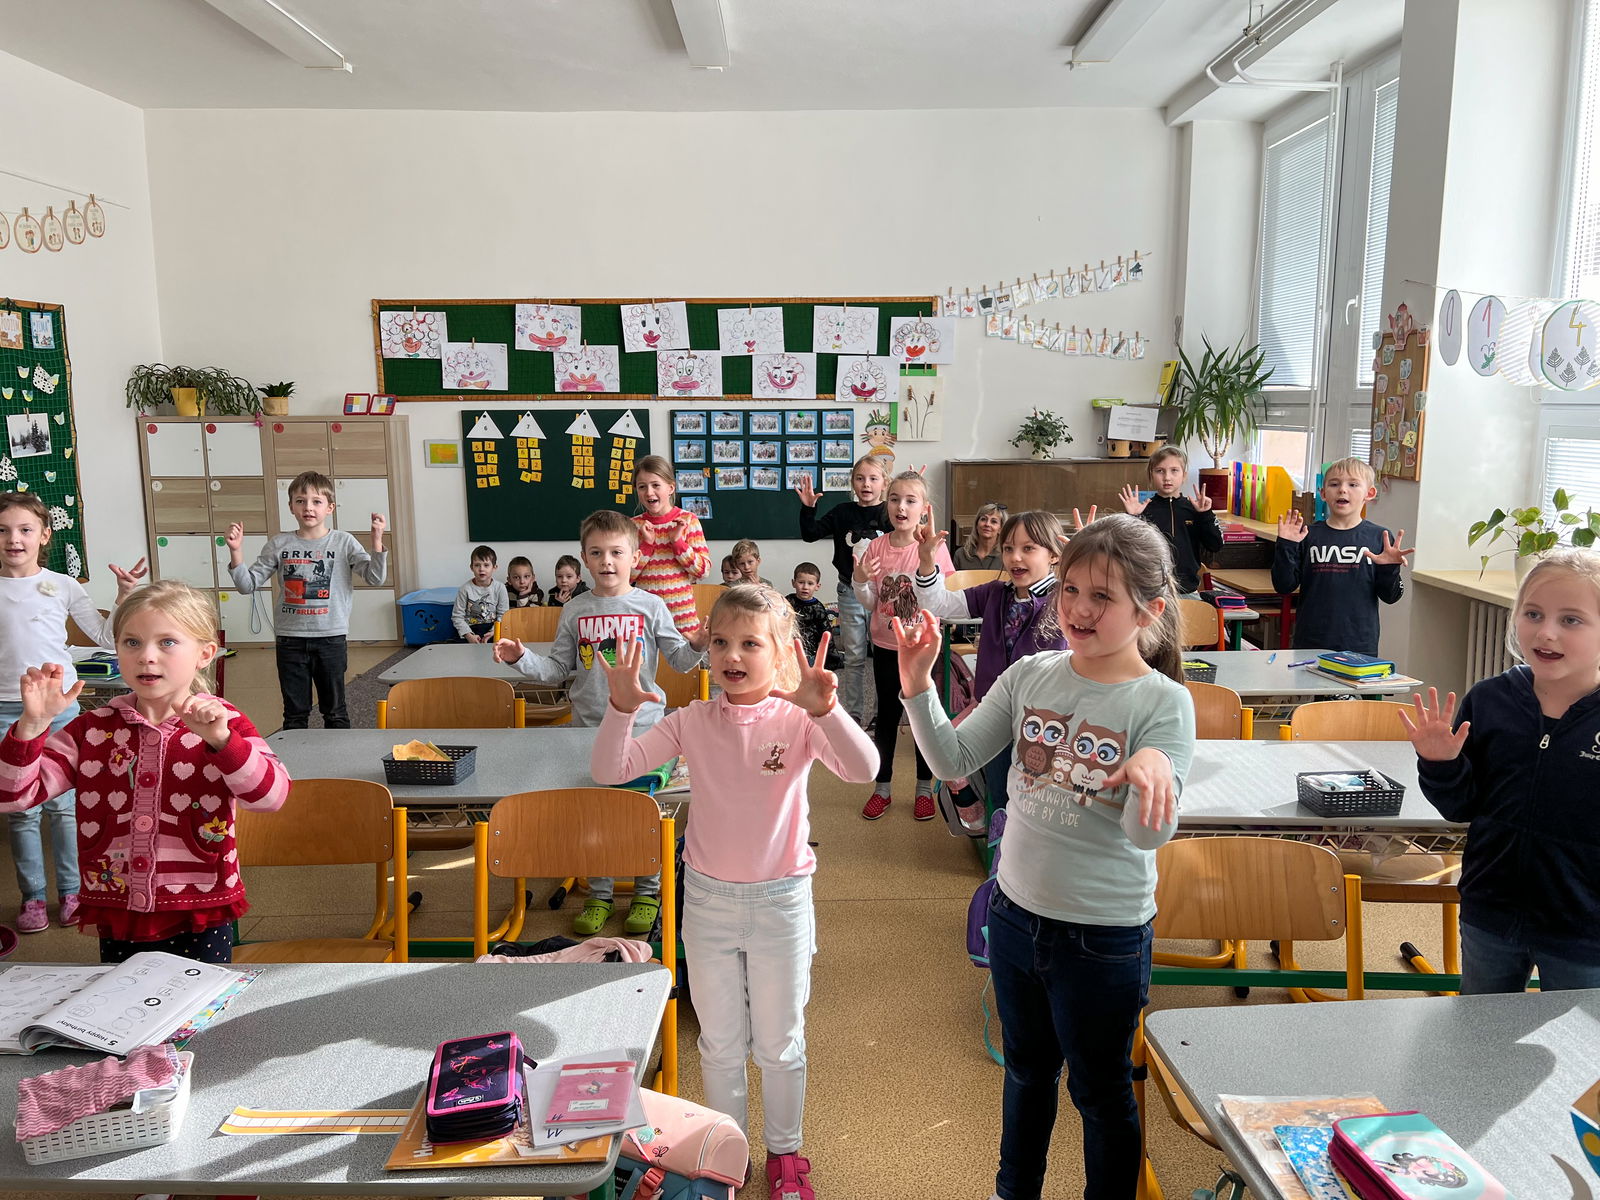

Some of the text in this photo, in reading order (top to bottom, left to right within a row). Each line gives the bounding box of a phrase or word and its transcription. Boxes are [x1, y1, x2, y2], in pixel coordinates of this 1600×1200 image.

[1482, 299, 1492, 338] 1
[1568, 304, 1588, 346] 4
[1310, 545, 1373, 565] NASA
[317, 590, 329, 598] 82
[580, 616, 643, 640] MARVEL
[1042, 806, 1055, 822] BY
[86, 1030, 108, 1041] Happy
